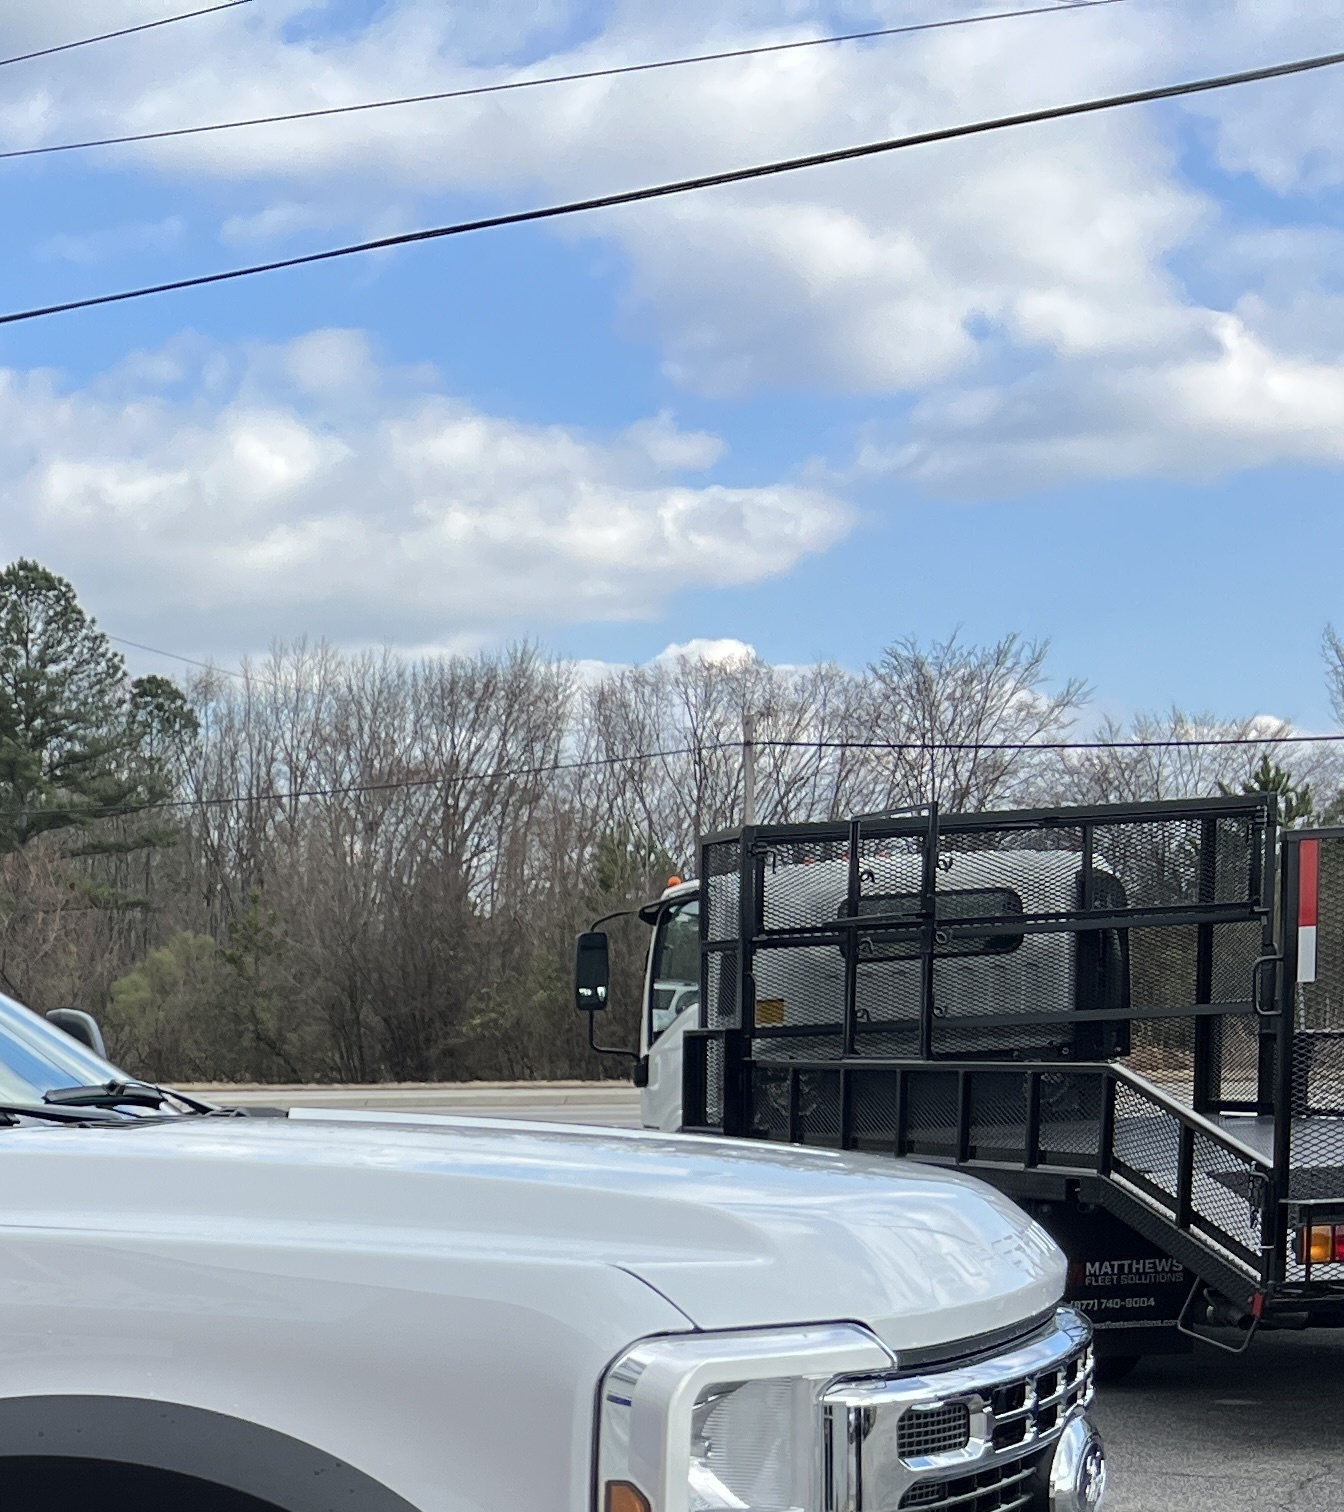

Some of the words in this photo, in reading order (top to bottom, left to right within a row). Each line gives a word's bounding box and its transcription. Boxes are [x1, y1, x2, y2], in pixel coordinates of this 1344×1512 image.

[1085, 1258, 1184, 1275] MATTHEWS
[1085, 1275, 1118, 1286] FLEET
[1120, 1272, 1184, 1285] SOLUTIONS
